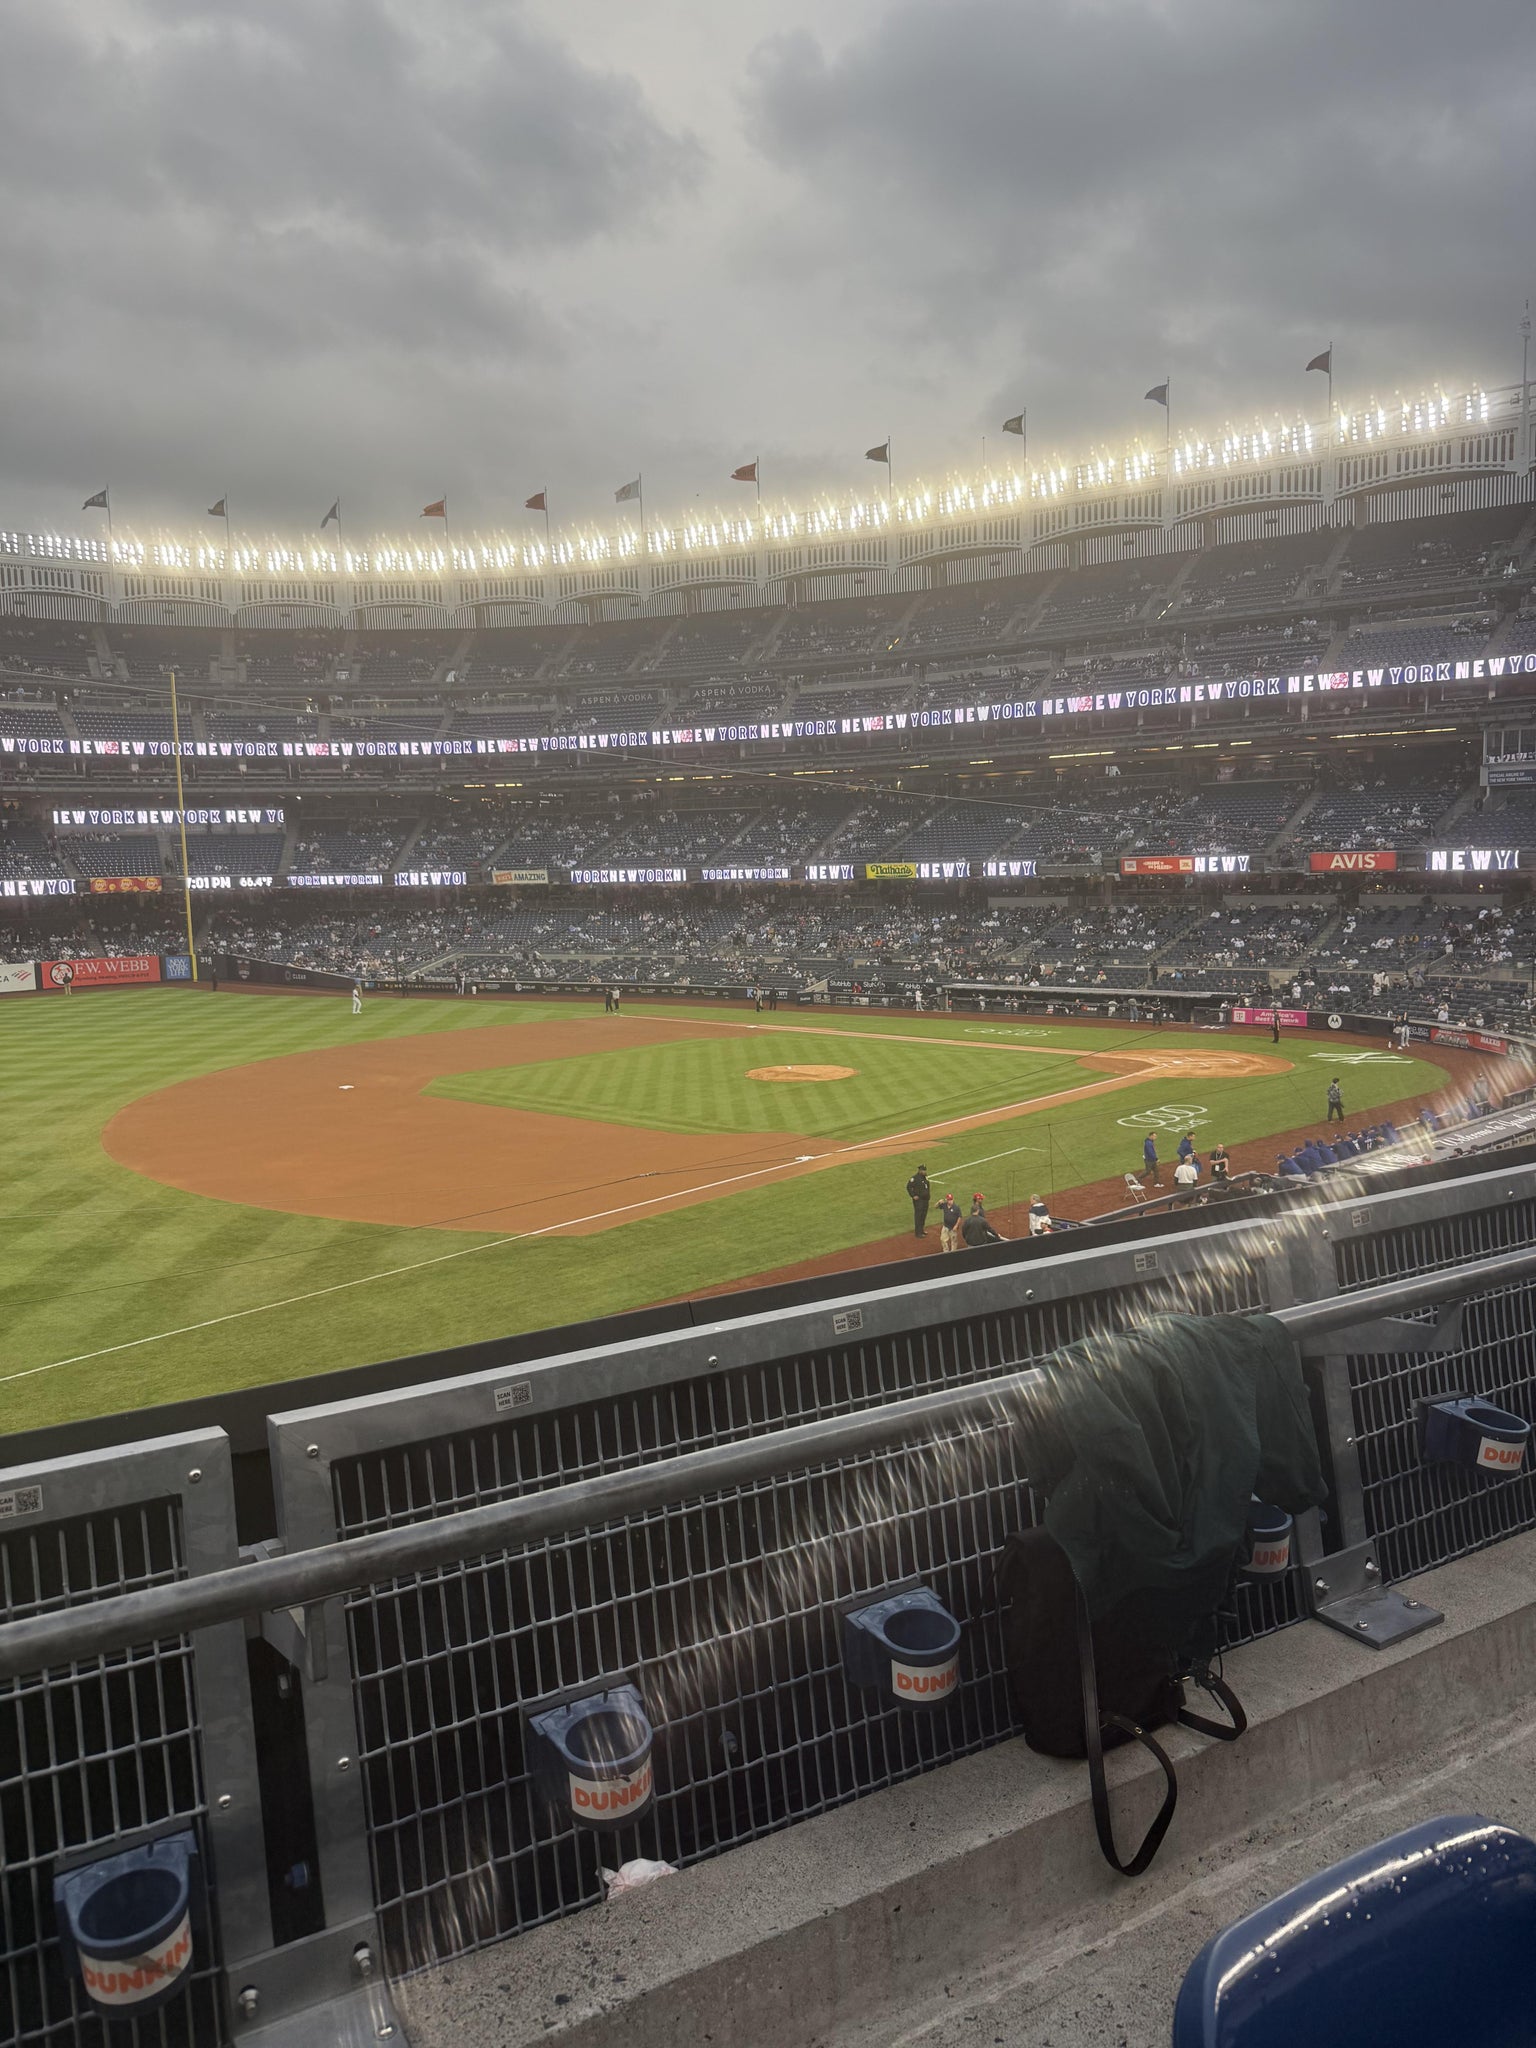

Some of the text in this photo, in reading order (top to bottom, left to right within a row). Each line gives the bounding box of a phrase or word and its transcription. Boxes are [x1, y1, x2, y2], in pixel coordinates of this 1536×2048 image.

[694, 685, 771, 698] ASPEN VODKA
[581, 693, 653, 705] ASPEN VODKA
[17, 739, 64, 753] YORK
[70, 740, 107, 754] NEW
[106, 741, 145, 755] EW
[150, 742, 194, 755] YORK
[197, 742, 232, 755] NEW
[234, 740, 277, 756] YORK
[283, 743, 317, 756] NEW
[315, 740, 353, 755] EW
[356, 742, 397, 755] YORK
[400, 742, 432, 755] NEW
[434, 741, 472, 754] YORK
[477, 739, 507, 753] NEW
[506, 738, 538, 752] EW
[541, 736, 577, 750] YORK
[579, 734, 608, 748] NEW
[610, 732, 647, 747] YORK
[652, 730, 682, 744] NEW
[681, 728, 715, 742] EW
[719, 725, 758, 740] YORK
[761, 723, 793, 738] NEW
[795, 720, 836, 736] YORK
[842, 717, 874, 733] NEW
[872, 714, 907, 730] EW
[911, 709, 951, 727] YORK
[955, 706, 989, 723] NEW
[992, 702, 1036, 720] YORK
[1043, 697, 1079, 715] NEW
[1077, 693, 1121, 711] EW
[1126, 687, 1176, 707] YORK
[1180, 683, 1222, 702] NEW
[1225, 676, 1279, 698] YORK
[1288, 673, 1333, 693] NEW
[1331, 669, 1384, 689] EW
[1389, 663, 1450, 684] YORK
[1455, 658, 1505, 679] NEW
[89, 811, 134, 824] YORK
[137, 810, 173, 824] NEW
[176, 810, 220, 823] YORK
[226, 810, 261, 823] NEW
[988, 860, 1021, 876] NEW
[1194, 857, 1237, 872] NEW
[1330, 854, 1376, 869] AVIS
[1431, 851, 1492, 871] NEW
[575, 870, 609, 883] YORK
[610, 870, 637, 882] NEW
[638, 869, 674, 882] YORK
[702, 870, 730, 879] YORK
[731, 869, 753, 879] NEW
[753, 868, 781, 879] YORK
[809, 865, 840, 879] NEW
[870, 864, 914, 878] Nathan's
[921, 863, 954, 878] NEW
[211, 876, 231, 888] PM
[290, 876, 321, 885] YORK
[320, 875, 346, 885] NEW
[344, 875, 375, 884] YORK
[410, 871, 441, 885] NEW
[4, 880, 44, 896] NEW
[75, 962, 101, 975] F.W.
[105, 960, 150, 972] WEBB
[497, 1391, 511, 1400] SCAN
[1483, 1446, 1525, 1465] DUN
[896, 1665, 958, 1694] DUNK
